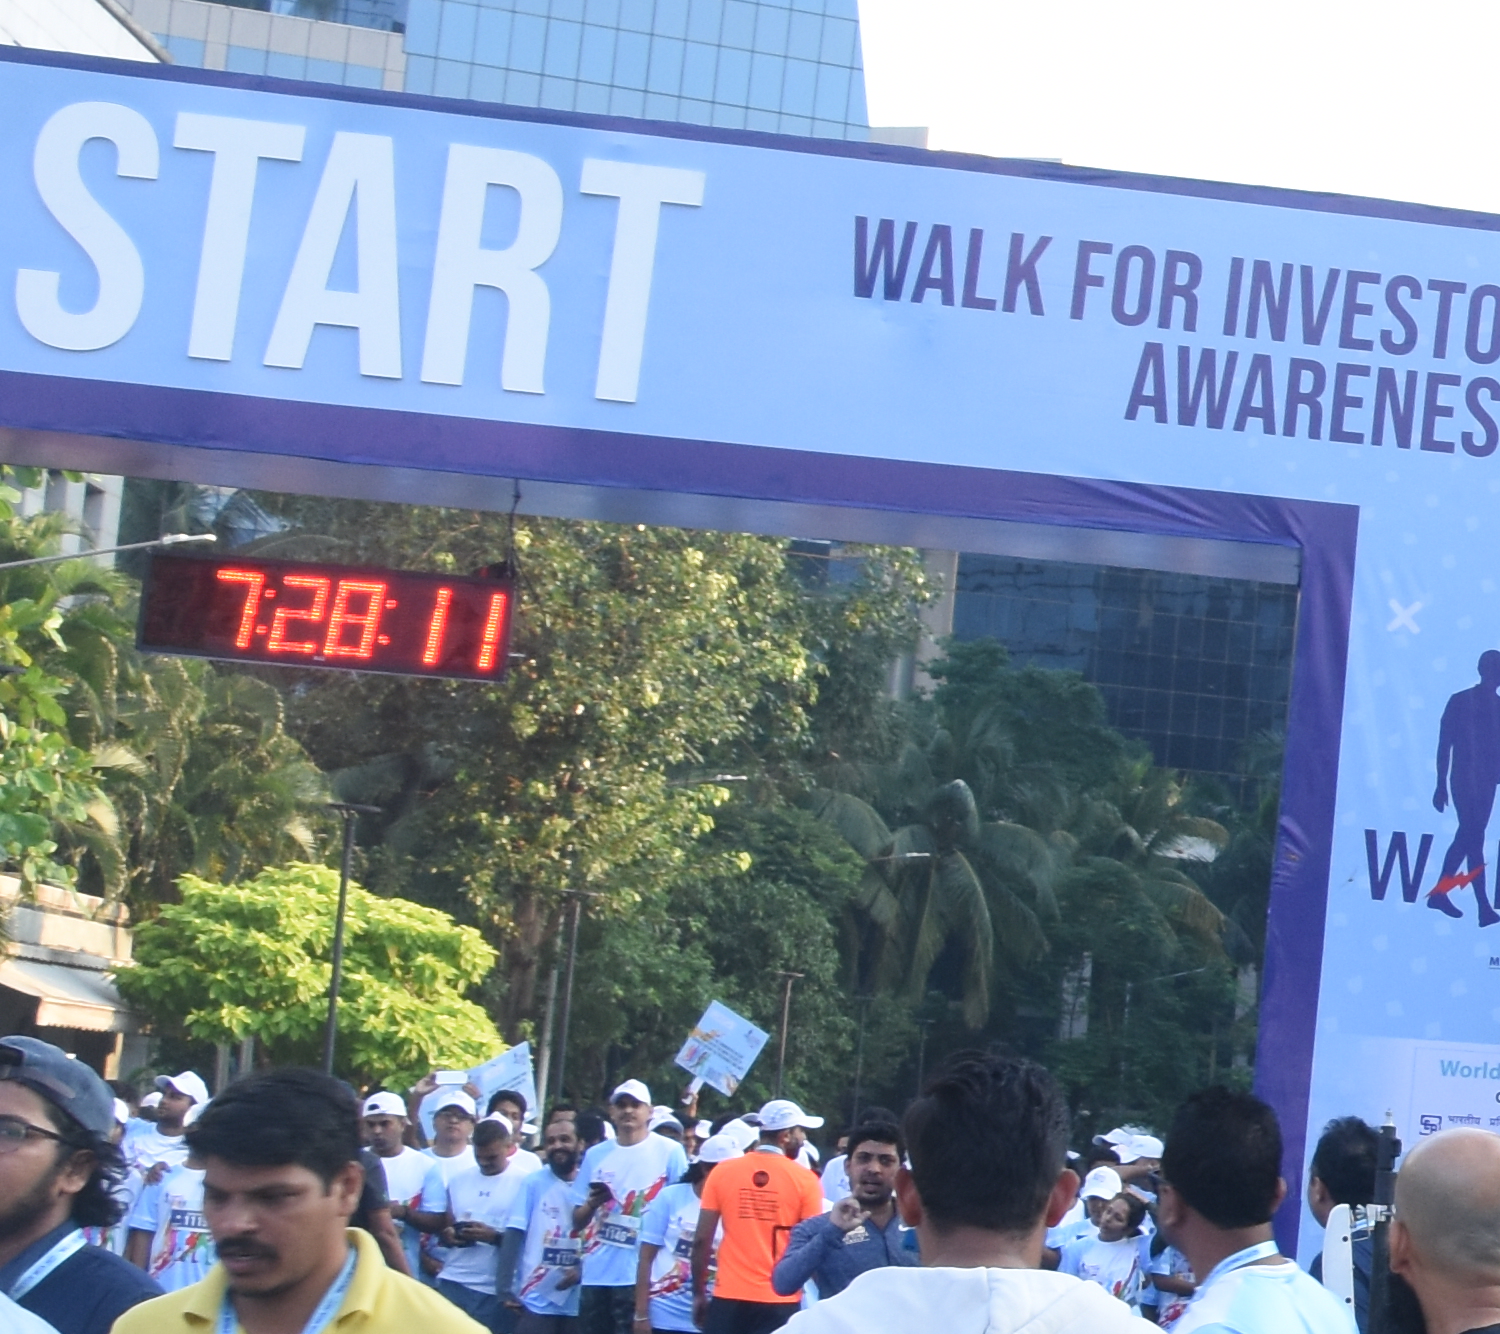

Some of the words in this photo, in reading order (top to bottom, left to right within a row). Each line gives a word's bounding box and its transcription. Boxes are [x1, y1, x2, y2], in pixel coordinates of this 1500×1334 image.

[15, 101, 706, 404] START
[853, 214, 1053, 317] WALK
[1070, 239, 1203, 334] FOR
[216, 568, 507, 670] 7:28:11
